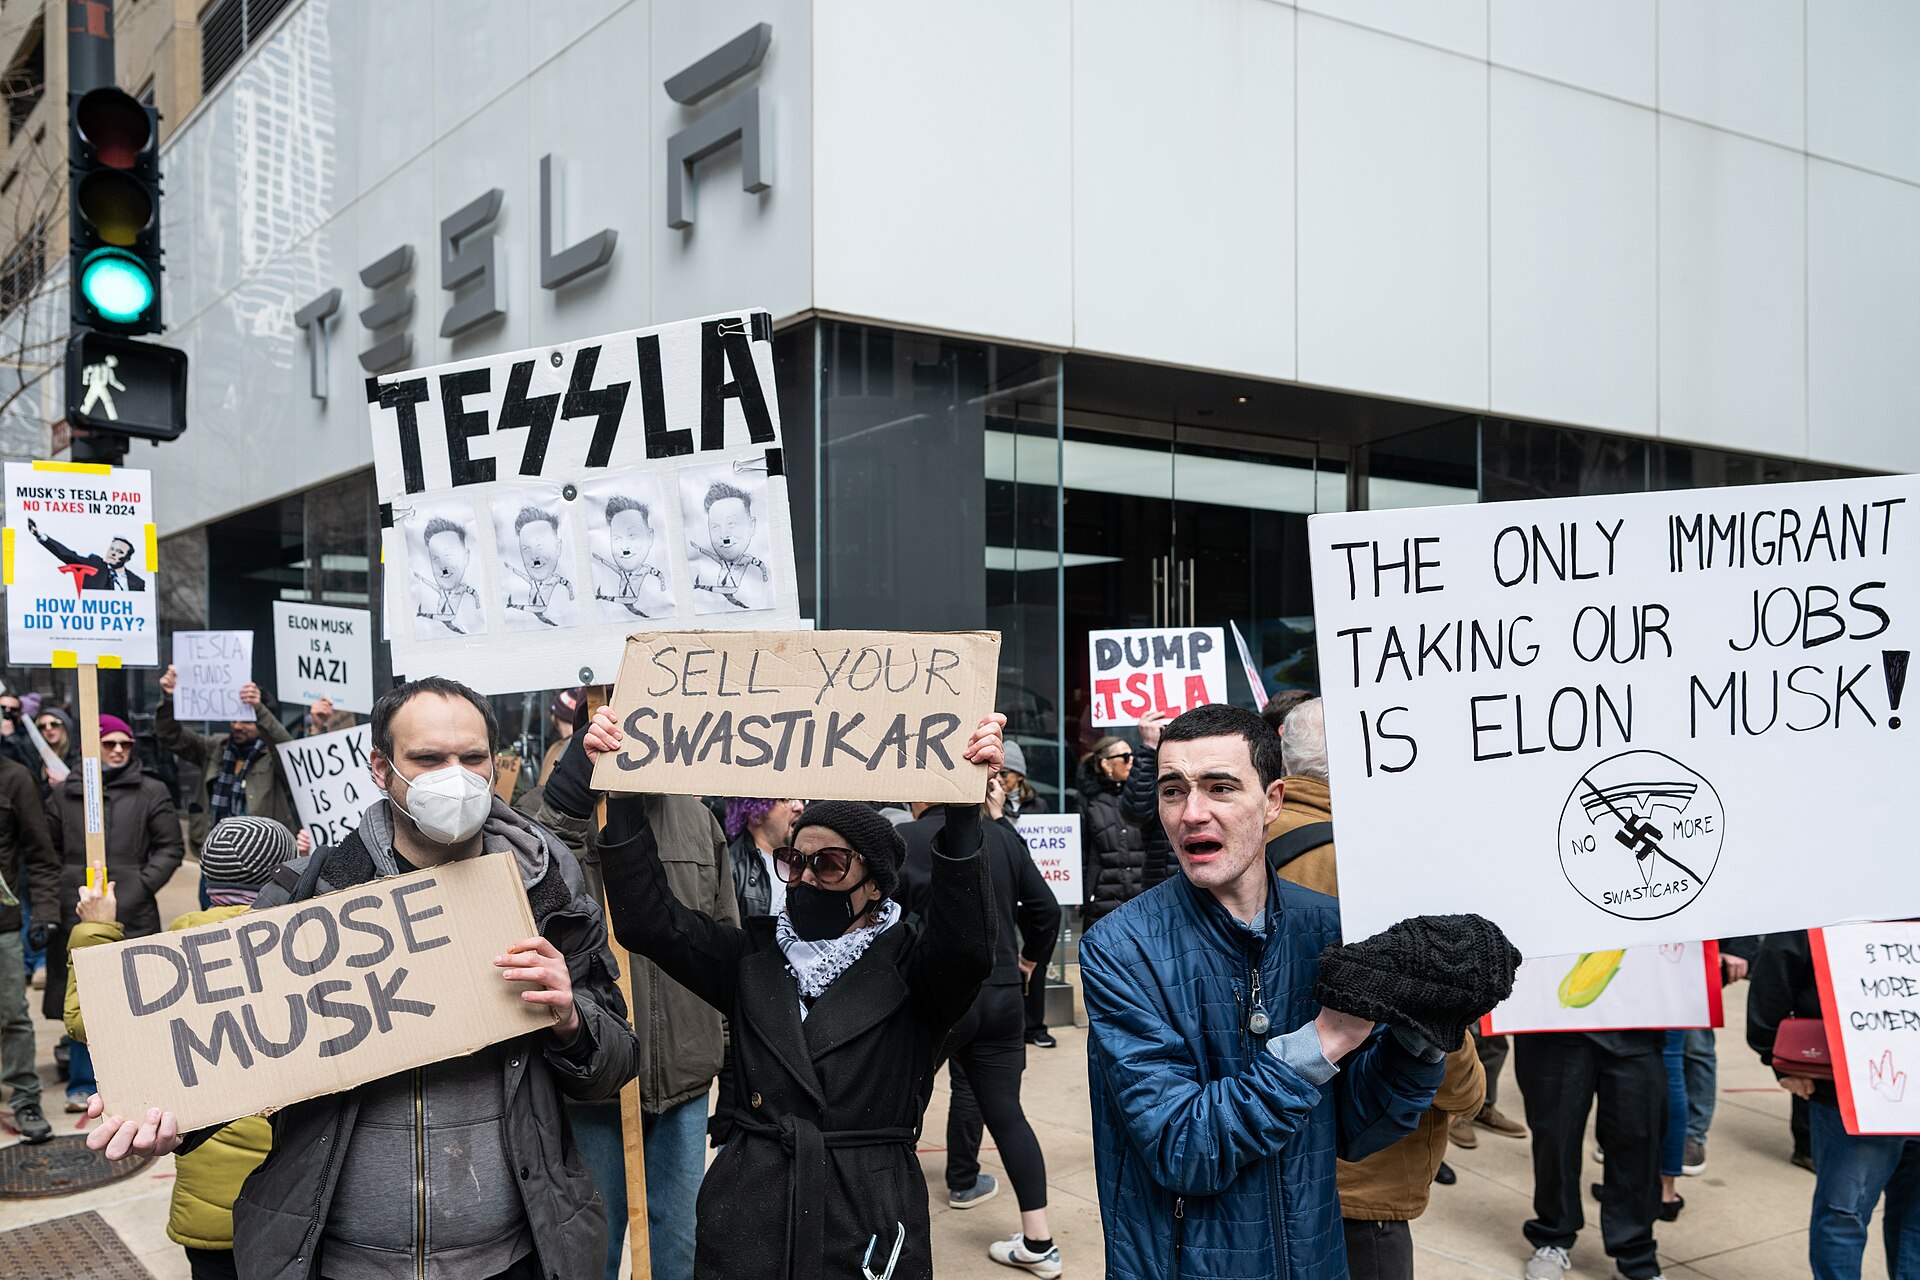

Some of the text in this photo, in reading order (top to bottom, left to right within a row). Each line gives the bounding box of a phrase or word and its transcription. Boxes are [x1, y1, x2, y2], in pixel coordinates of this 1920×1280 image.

[295, 22, 772, 400] TESLA
[379, 317, 776, 494] TESSLA
[16, 486, 141, 503] MUSK'S TESLA PAID
[23, 500, 136, 515] NO TAXES IN 2024
[1331, 498, 1906, 600] THE ONLY IMMIGRANT
[36, 598, 133, 615] HOW MUCH
[24, 614, 145, 631] DID YOU PAY?
[288, 615, 354, 635] ELON MUSK
[1337, 582, 1891, 687] TAKING OUR JOBS
[184, 634, 244, 661] TESLA
[310, 638, 332, 653] IS A
[1095, 631, 1214, 671] DUMP
[193, 663, 232, 685] FUNDS
[298, 655, 347, 684] NAZI
[647, 646, 961, 705] SELL YOUR
[1360, 650, 1911, 777] IS ELON MUSK!
[616, 706, 962, 772] SWASTIKAR
[287, 732, 368, 787] MUSK
[311, 782, 359, 814] is a
[309, 811, 363, 847] DES
[1017, 826, 1073, 835] WANT YOUR
[1025, 838, 1066, 849] CARS
[1572, 816, 1714, 855] NO MORE
[1034, 858, 1061, 867] -WAY
[1603, 879, 1689, 904] SWASTICARS
[121, 878, 451, 1017] DEPOSE
[1860, 976, 1919, 998] MORE
[170, 967, 435, 1087] MUSK
